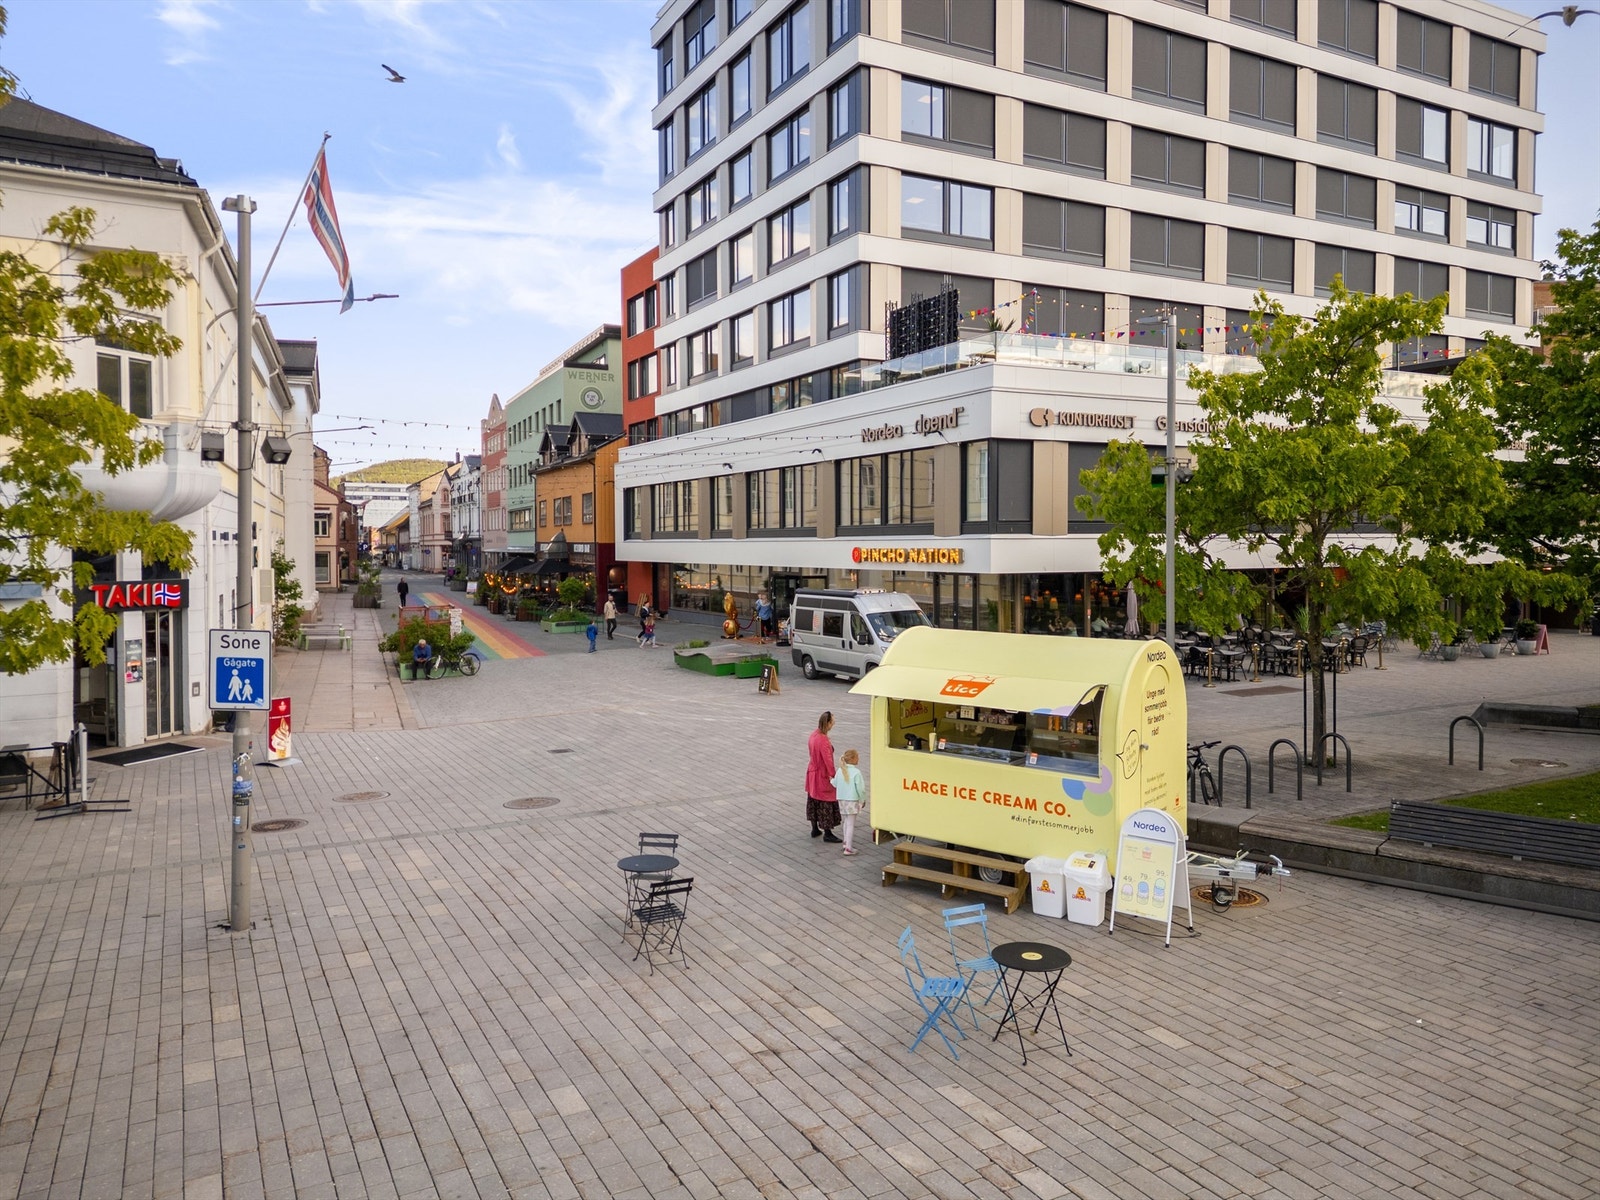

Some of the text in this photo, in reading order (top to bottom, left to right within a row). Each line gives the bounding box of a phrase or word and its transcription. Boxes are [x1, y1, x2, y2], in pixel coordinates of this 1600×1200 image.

[567, 371, 615, 382] WERNER
[1057, 411, 1137, 430] KONTORHUSET
[861, 423, 904, 442] Nordea
[861, 548, 963, 564] PINCHO NATION
[220, 634, 261, 650] Sone
[223, 658, 257, 669] Gågate
[1147, 651, 1167, 662] Nordea
[903, 778, 1072, 818] LARGE ICE CREAM CO.
[1010, 814, 1095, 835] #dinførstesommerjobb
[1133, 821, 1166, 833] Nordea
